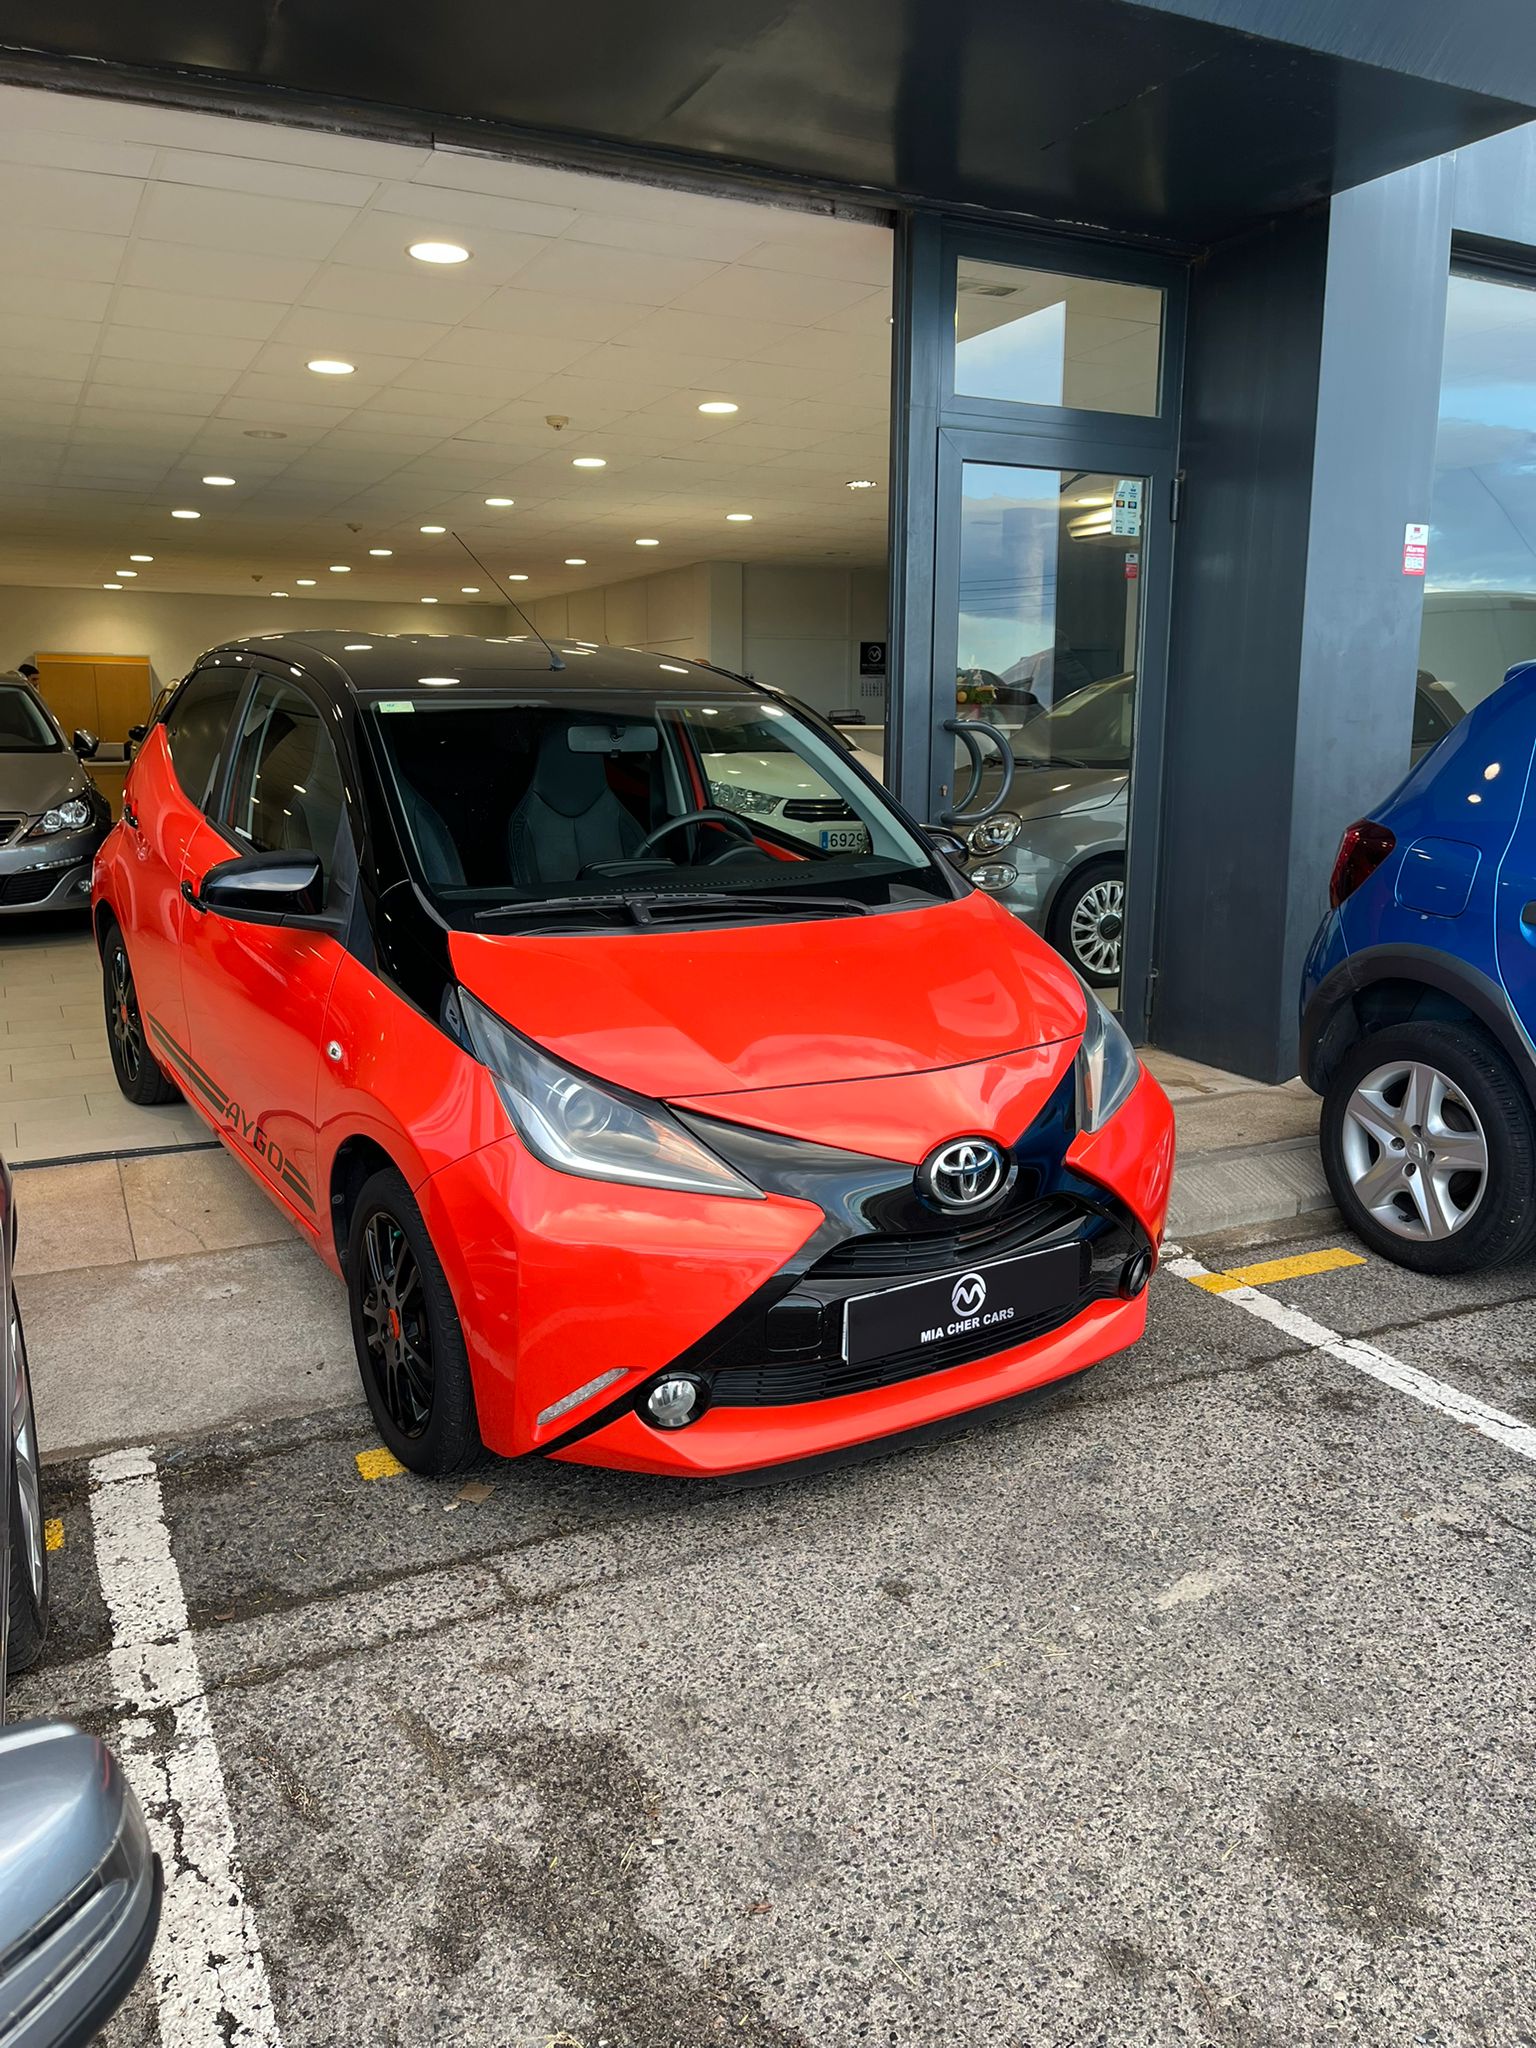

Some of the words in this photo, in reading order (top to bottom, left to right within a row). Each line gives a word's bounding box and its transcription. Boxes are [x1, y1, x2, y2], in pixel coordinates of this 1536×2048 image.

[830, 833, 863, 847] 6929
[226, 1102, 283, 1172] AYGO
[921, 1327, 944, 1343] MIA
[947, 1317, 980, 1335] CHER
[983, 1307, 1015, 1324] CARS
